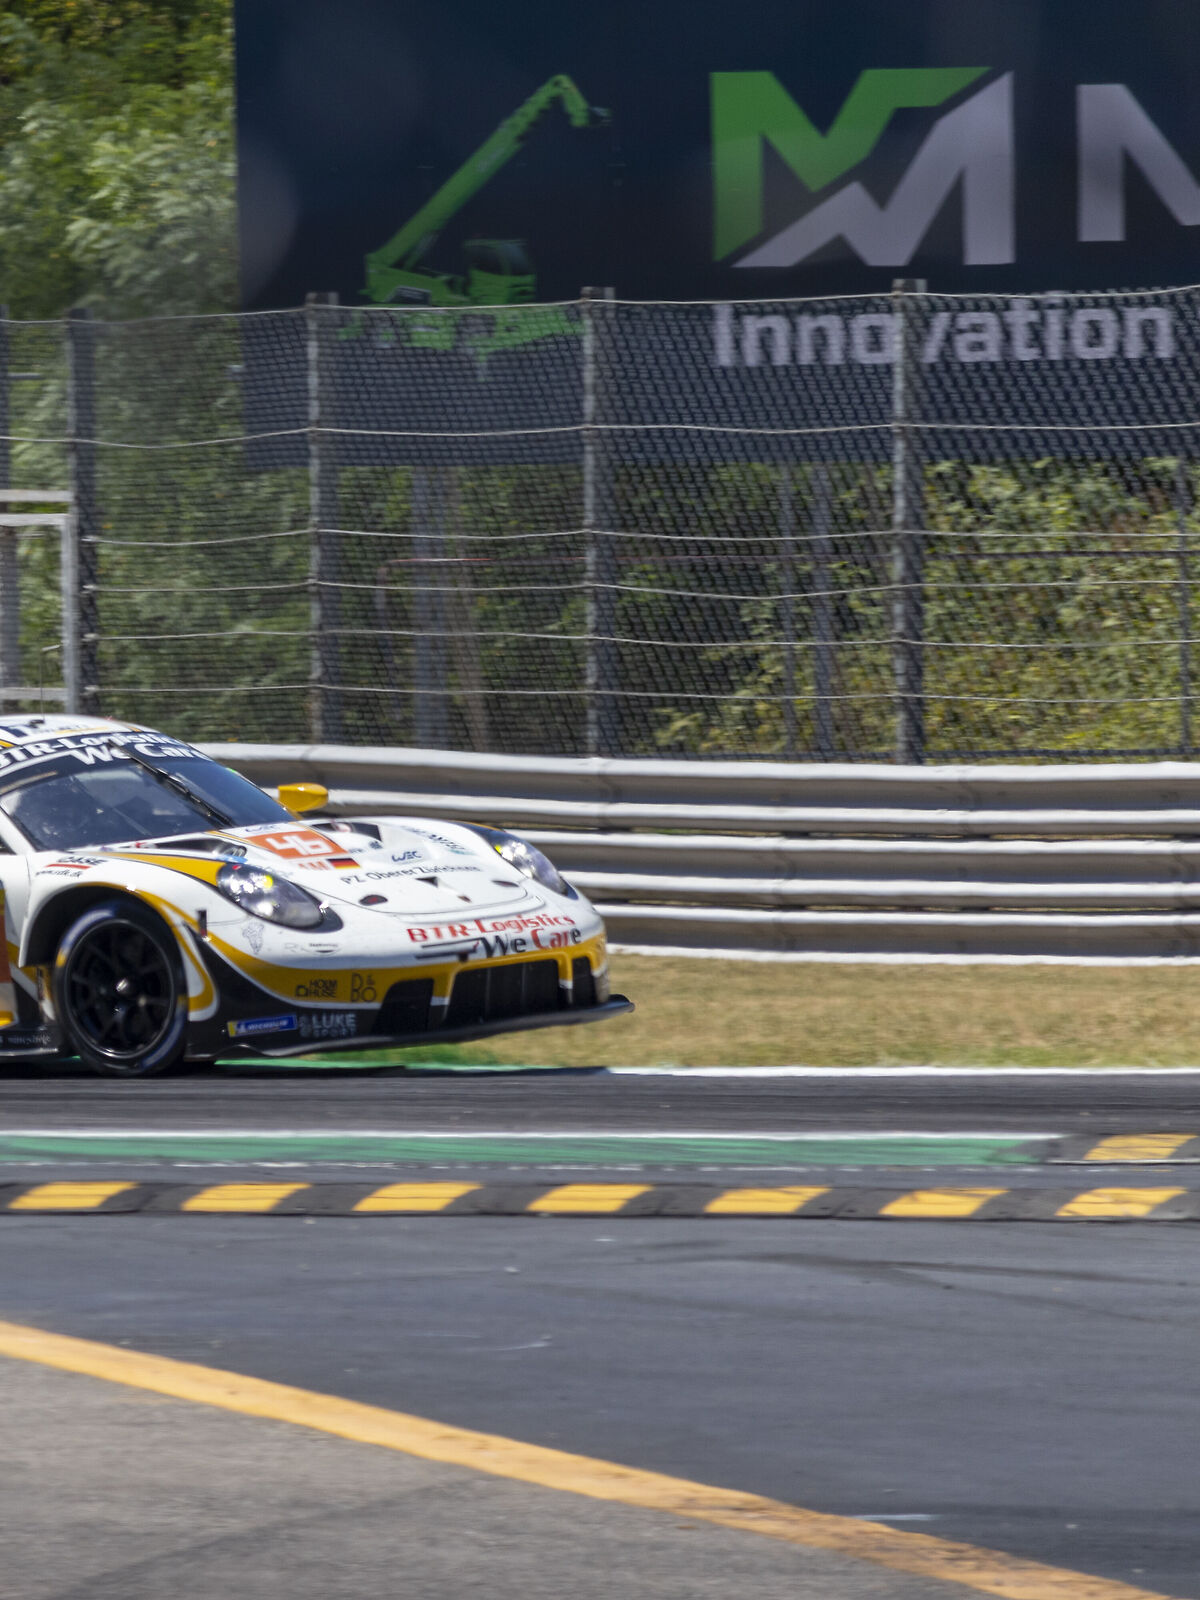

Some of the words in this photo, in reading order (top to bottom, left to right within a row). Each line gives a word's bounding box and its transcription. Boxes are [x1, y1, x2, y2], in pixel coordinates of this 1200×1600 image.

[712, 293, 1175, 366] Innovation
[265, 834, 333, 857] 46
[406, 914, 576, 942] BTR-Logistics
[482, 935, 527, 957] We
[530, 928, 582, 949] Care
[312, 1013, 357, 1028] LUKE
